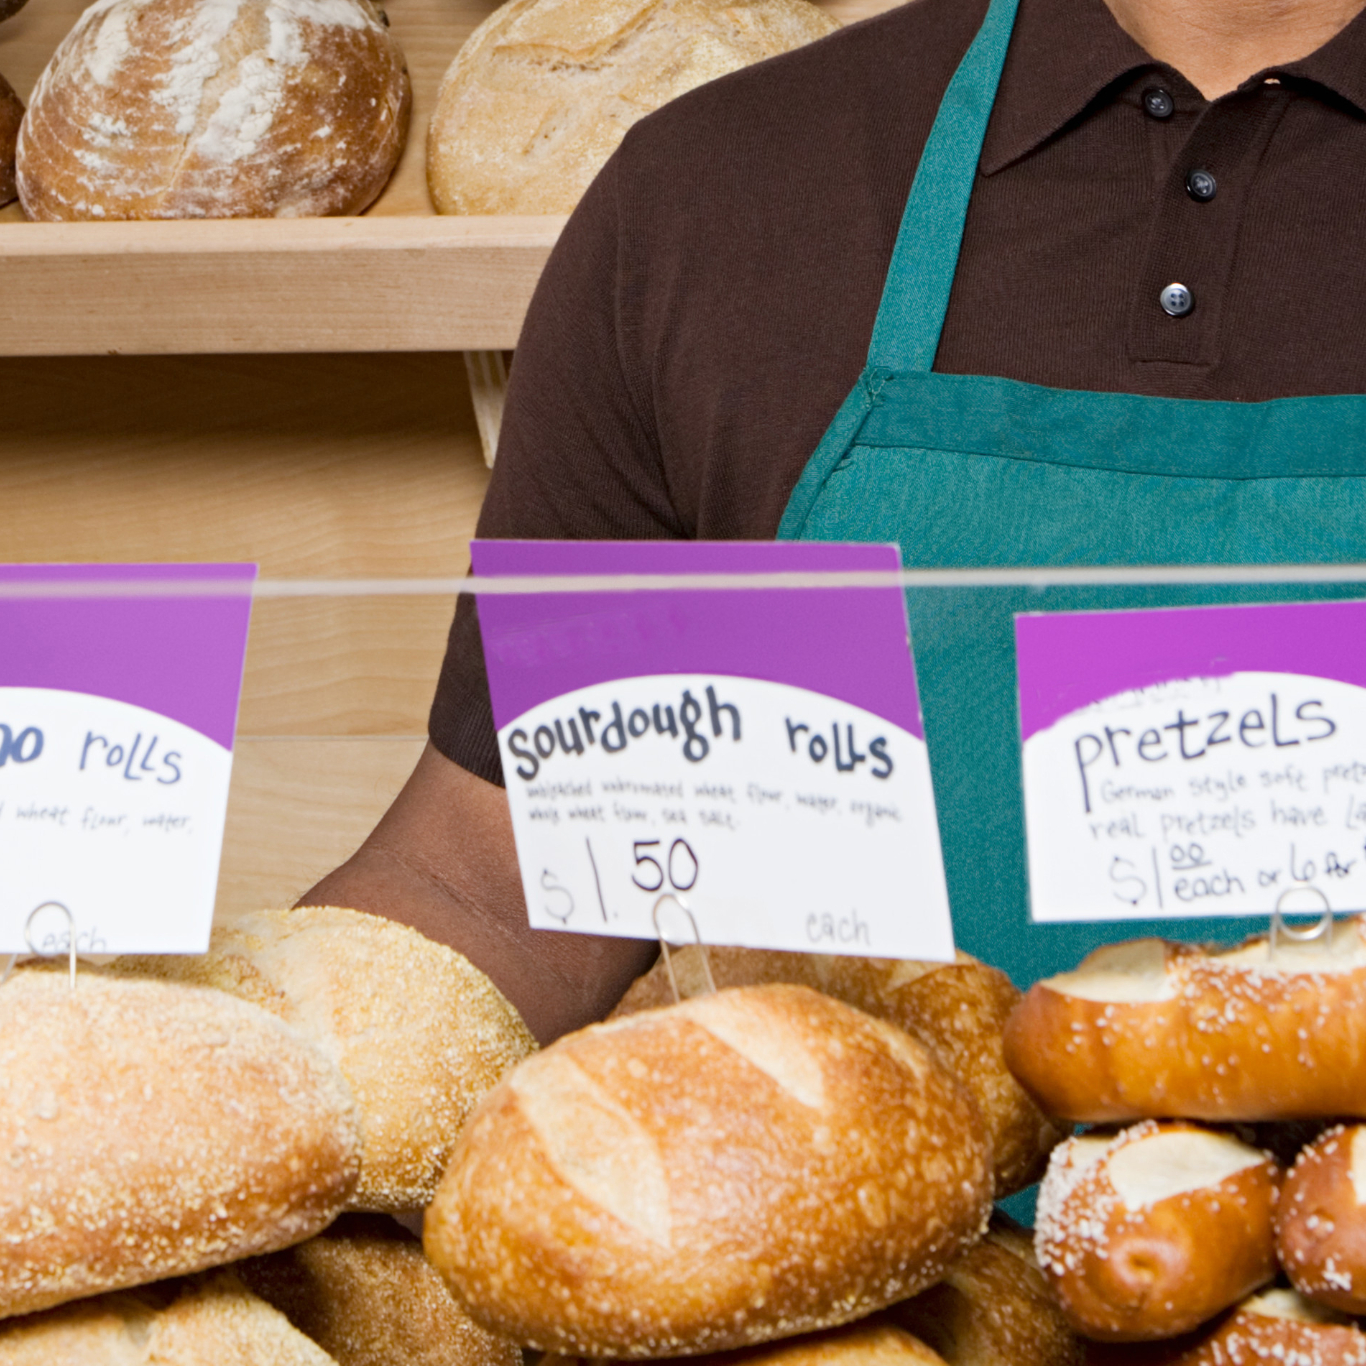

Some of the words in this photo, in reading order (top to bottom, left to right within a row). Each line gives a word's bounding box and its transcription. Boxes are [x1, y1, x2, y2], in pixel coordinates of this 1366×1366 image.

[507, 684, 743, 782] sourdough
[784, 715, 896, 780] rolls
[1073, 692, 1337, 815] pretzels
[79, 729, 183, 786] rolls
[1188, 771, 1249, 803] style
[1259, 763, 1308, 790] soft
[1089, 812, 1146, 840] real
[1160, 804, 1257, 840] pretzels
[1270, 798, 1329, 827] have
[1173, 868, 1247, 903] each
[804, 909, 872, 947] each
